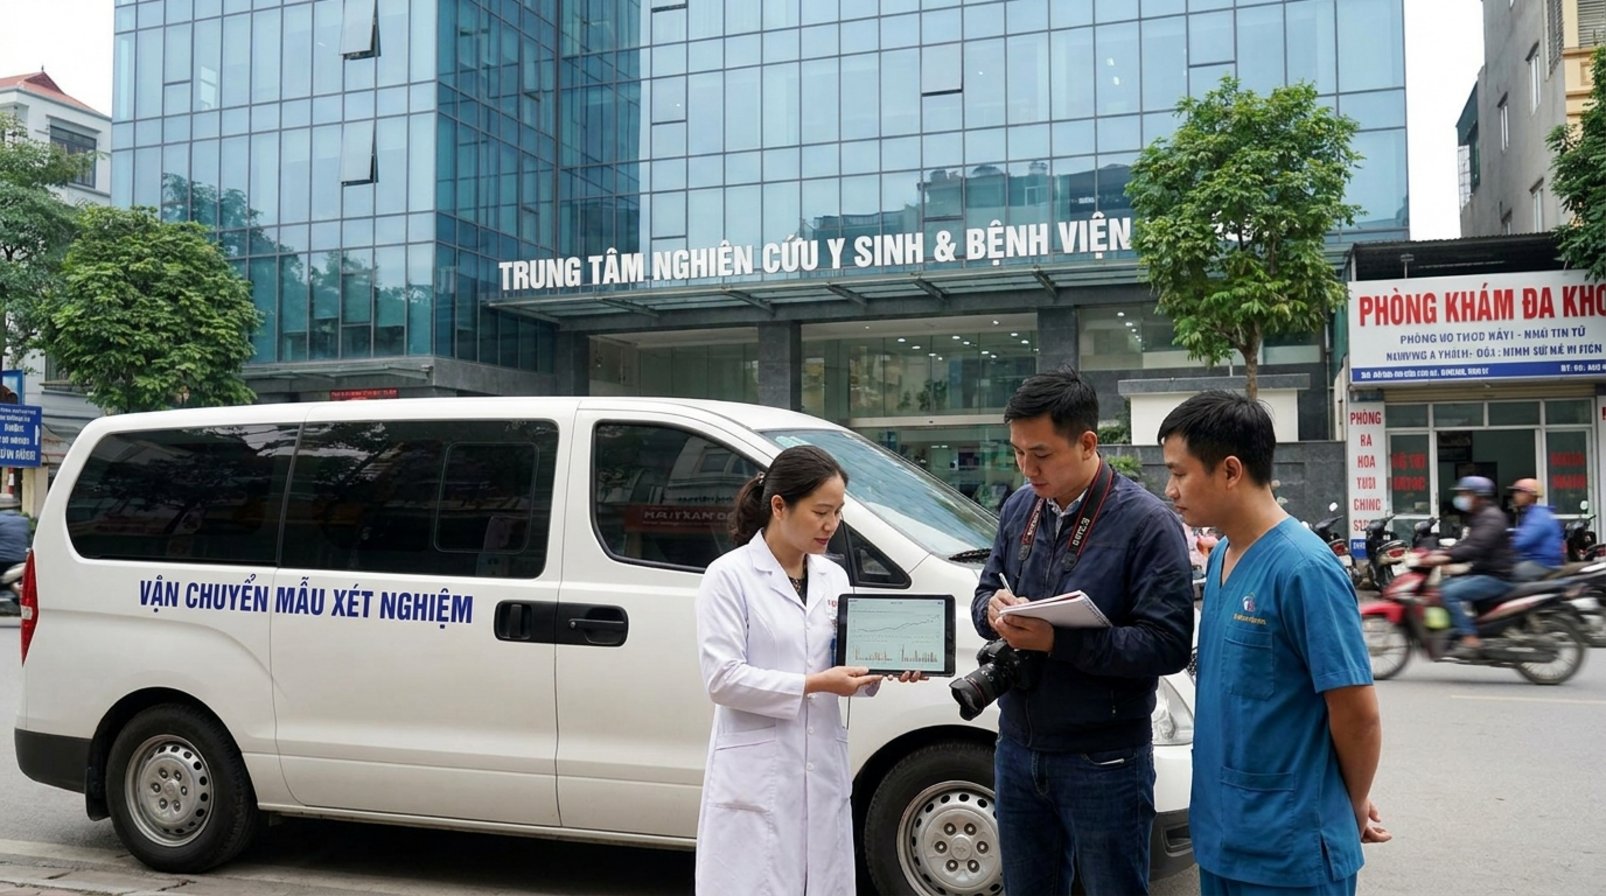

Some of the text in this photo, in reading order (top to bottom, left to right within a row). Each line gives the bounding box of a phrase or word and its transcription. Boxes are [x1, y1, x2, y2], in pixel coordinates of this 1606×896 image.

[499, 210, 1132, 291] TRUNG TÂM NGHIÊN CỨU Y SINH & BỆNH VIỆN
[1359, 287, 1437, 327] PHÒNG
[1445, 282, 1515, 323] KHÁM
[1522, 286, 1556, 319] ĐA
[1350, 408, 1382, 425] PHÒNG
[1357, 455, 1376, 468] HOA
[139, 573, 474, 629] VẬN CHUYỂN MẪU XÉT NGHIỆM
